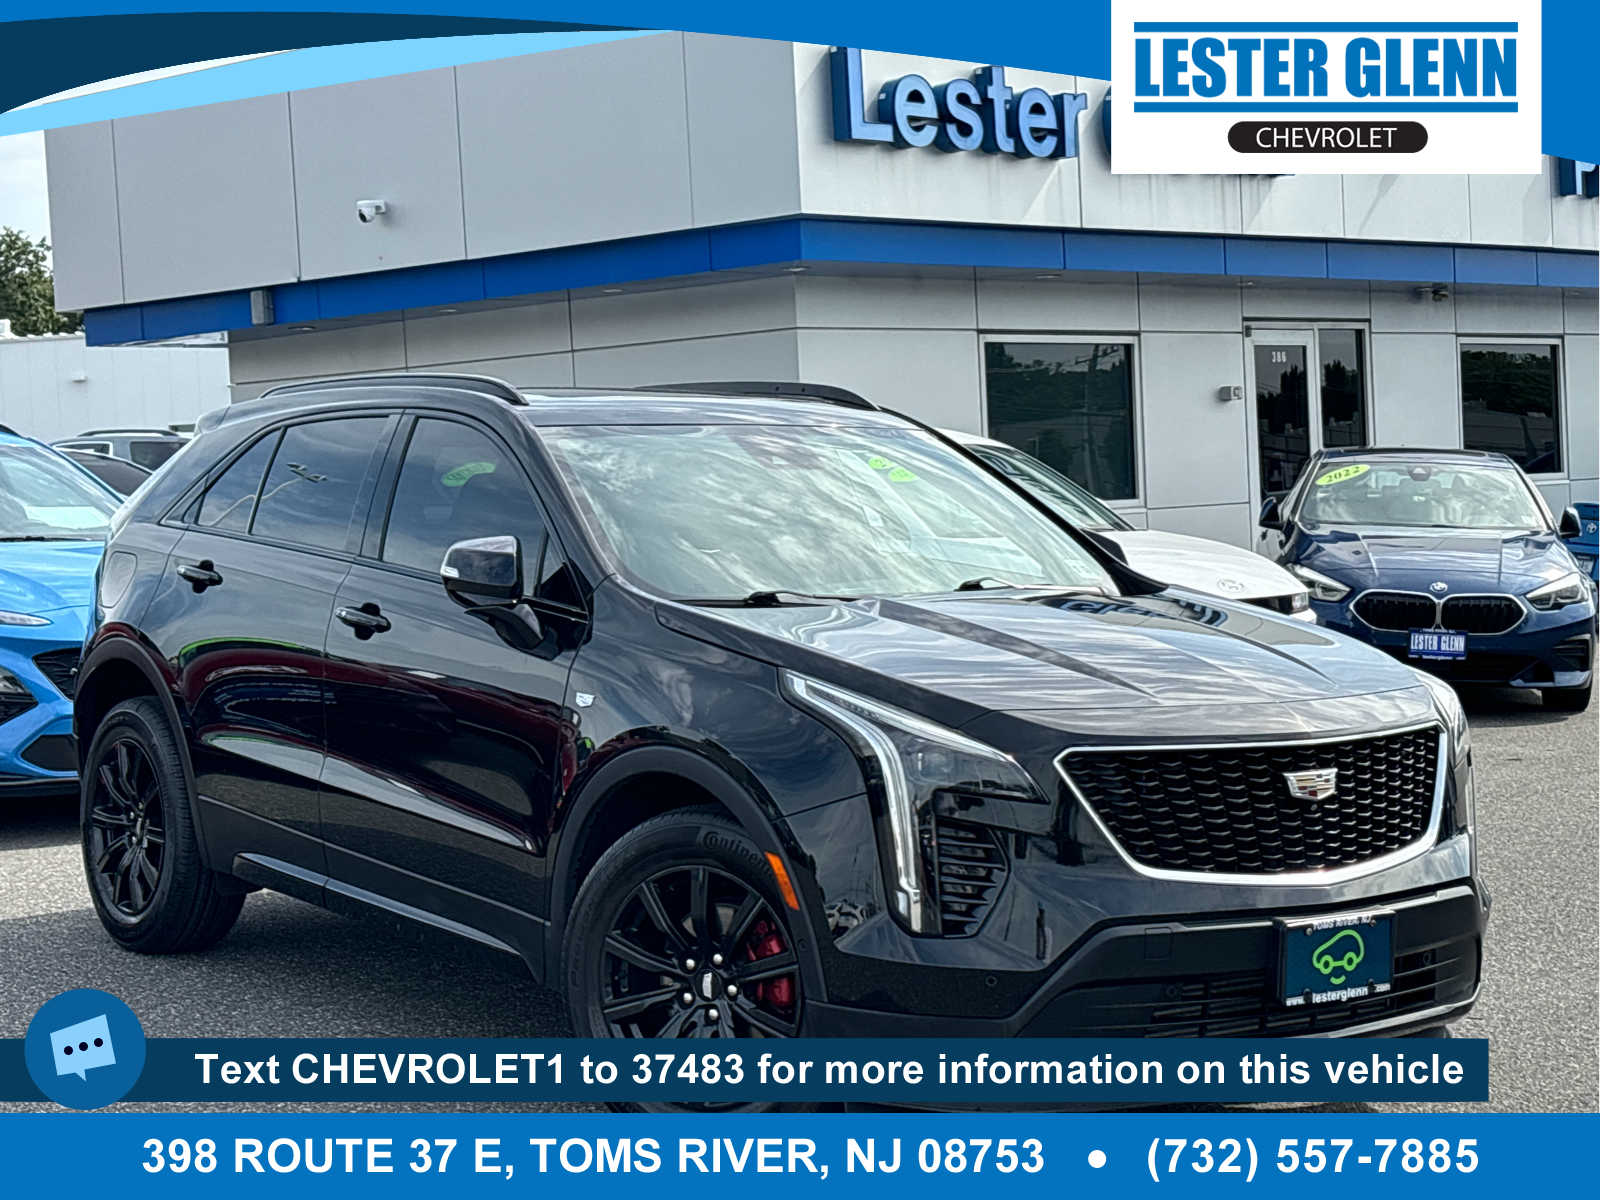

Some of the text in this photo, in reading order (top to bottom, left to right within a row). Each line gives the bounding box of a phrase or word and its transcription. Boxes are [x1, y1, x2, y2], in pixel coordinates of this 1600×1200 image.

[836, 46, 1088, 159] Lester
[1410, 633, 1465, 652] LESTER GLENN
